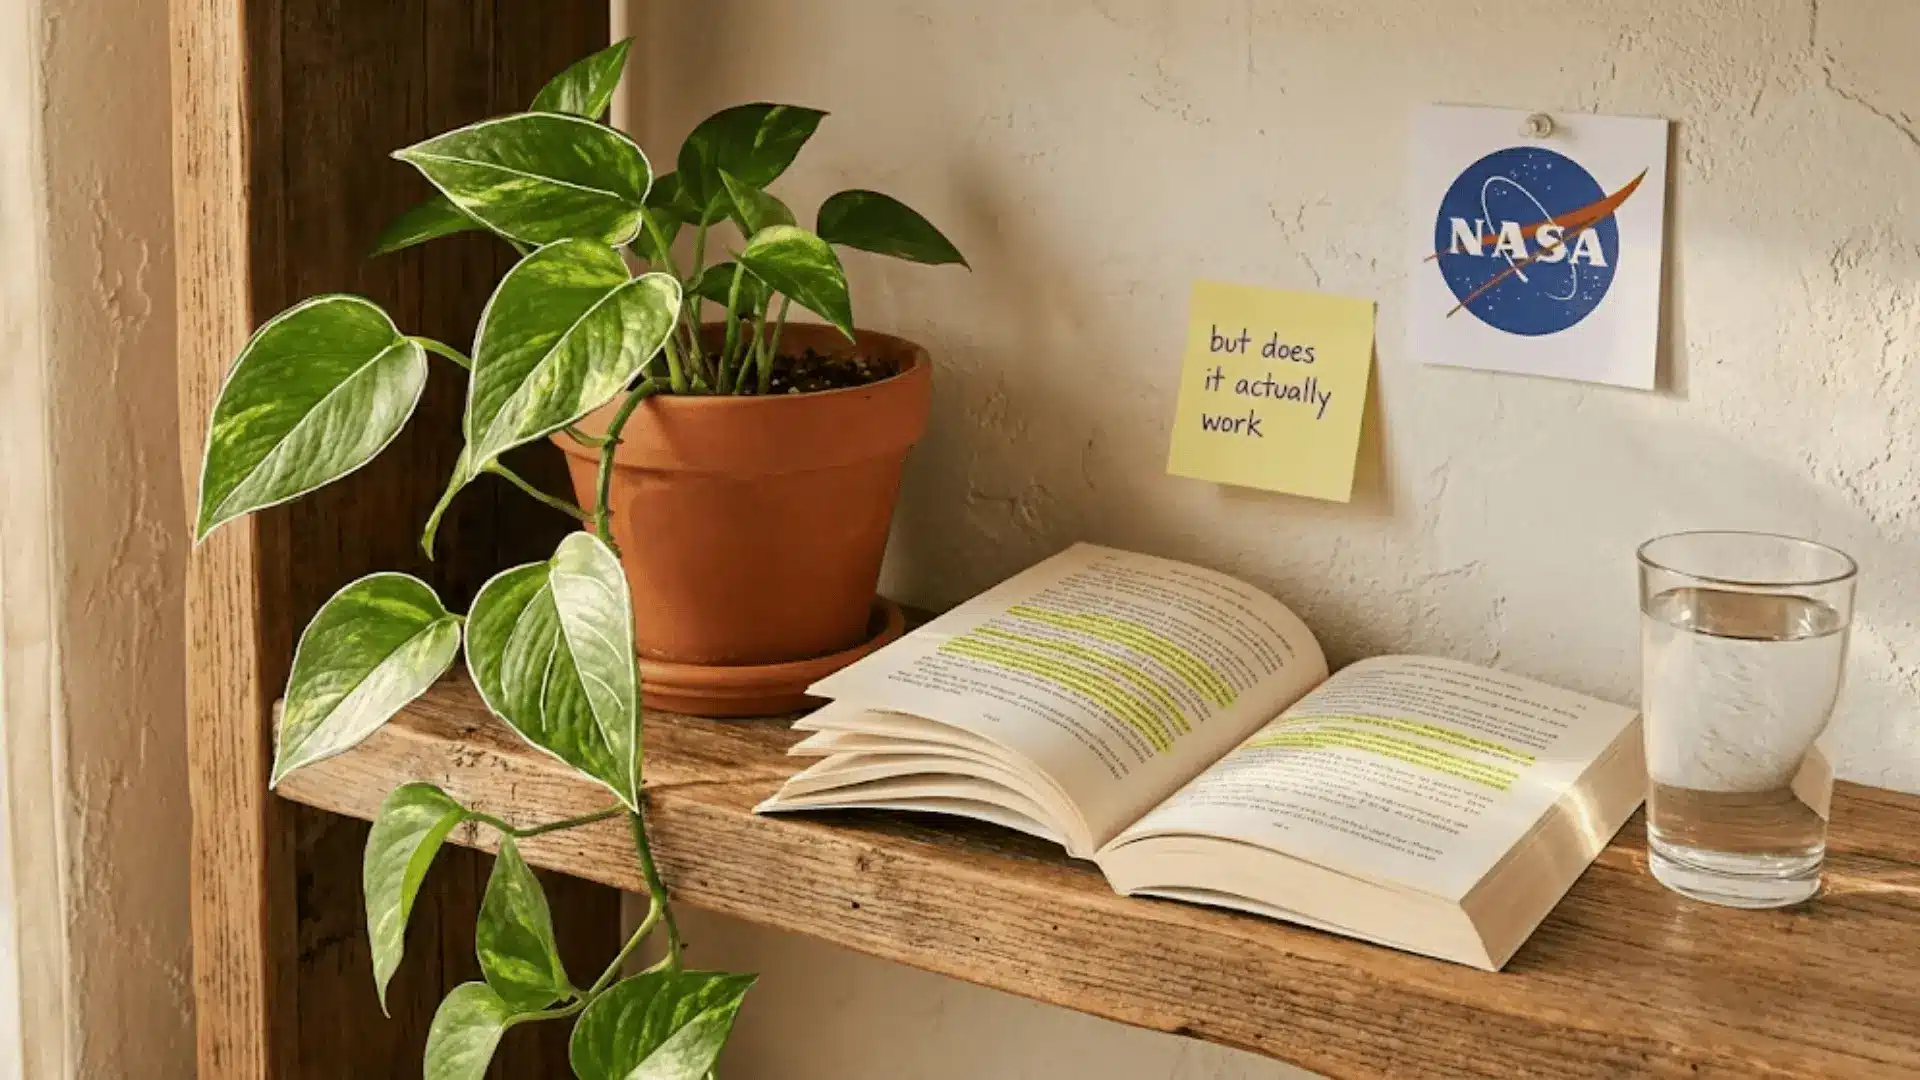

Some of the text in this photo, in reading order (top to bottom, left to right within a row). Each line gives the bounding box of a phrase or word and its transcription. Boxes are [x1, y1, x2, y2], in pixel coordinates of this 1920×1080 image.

[1450, 217, 1608, 267] NASA
[1210, 324, 1315, 364] but does
[1204, 366, 1332, 420] it actually
[1202, 409, 1263, 438] work
